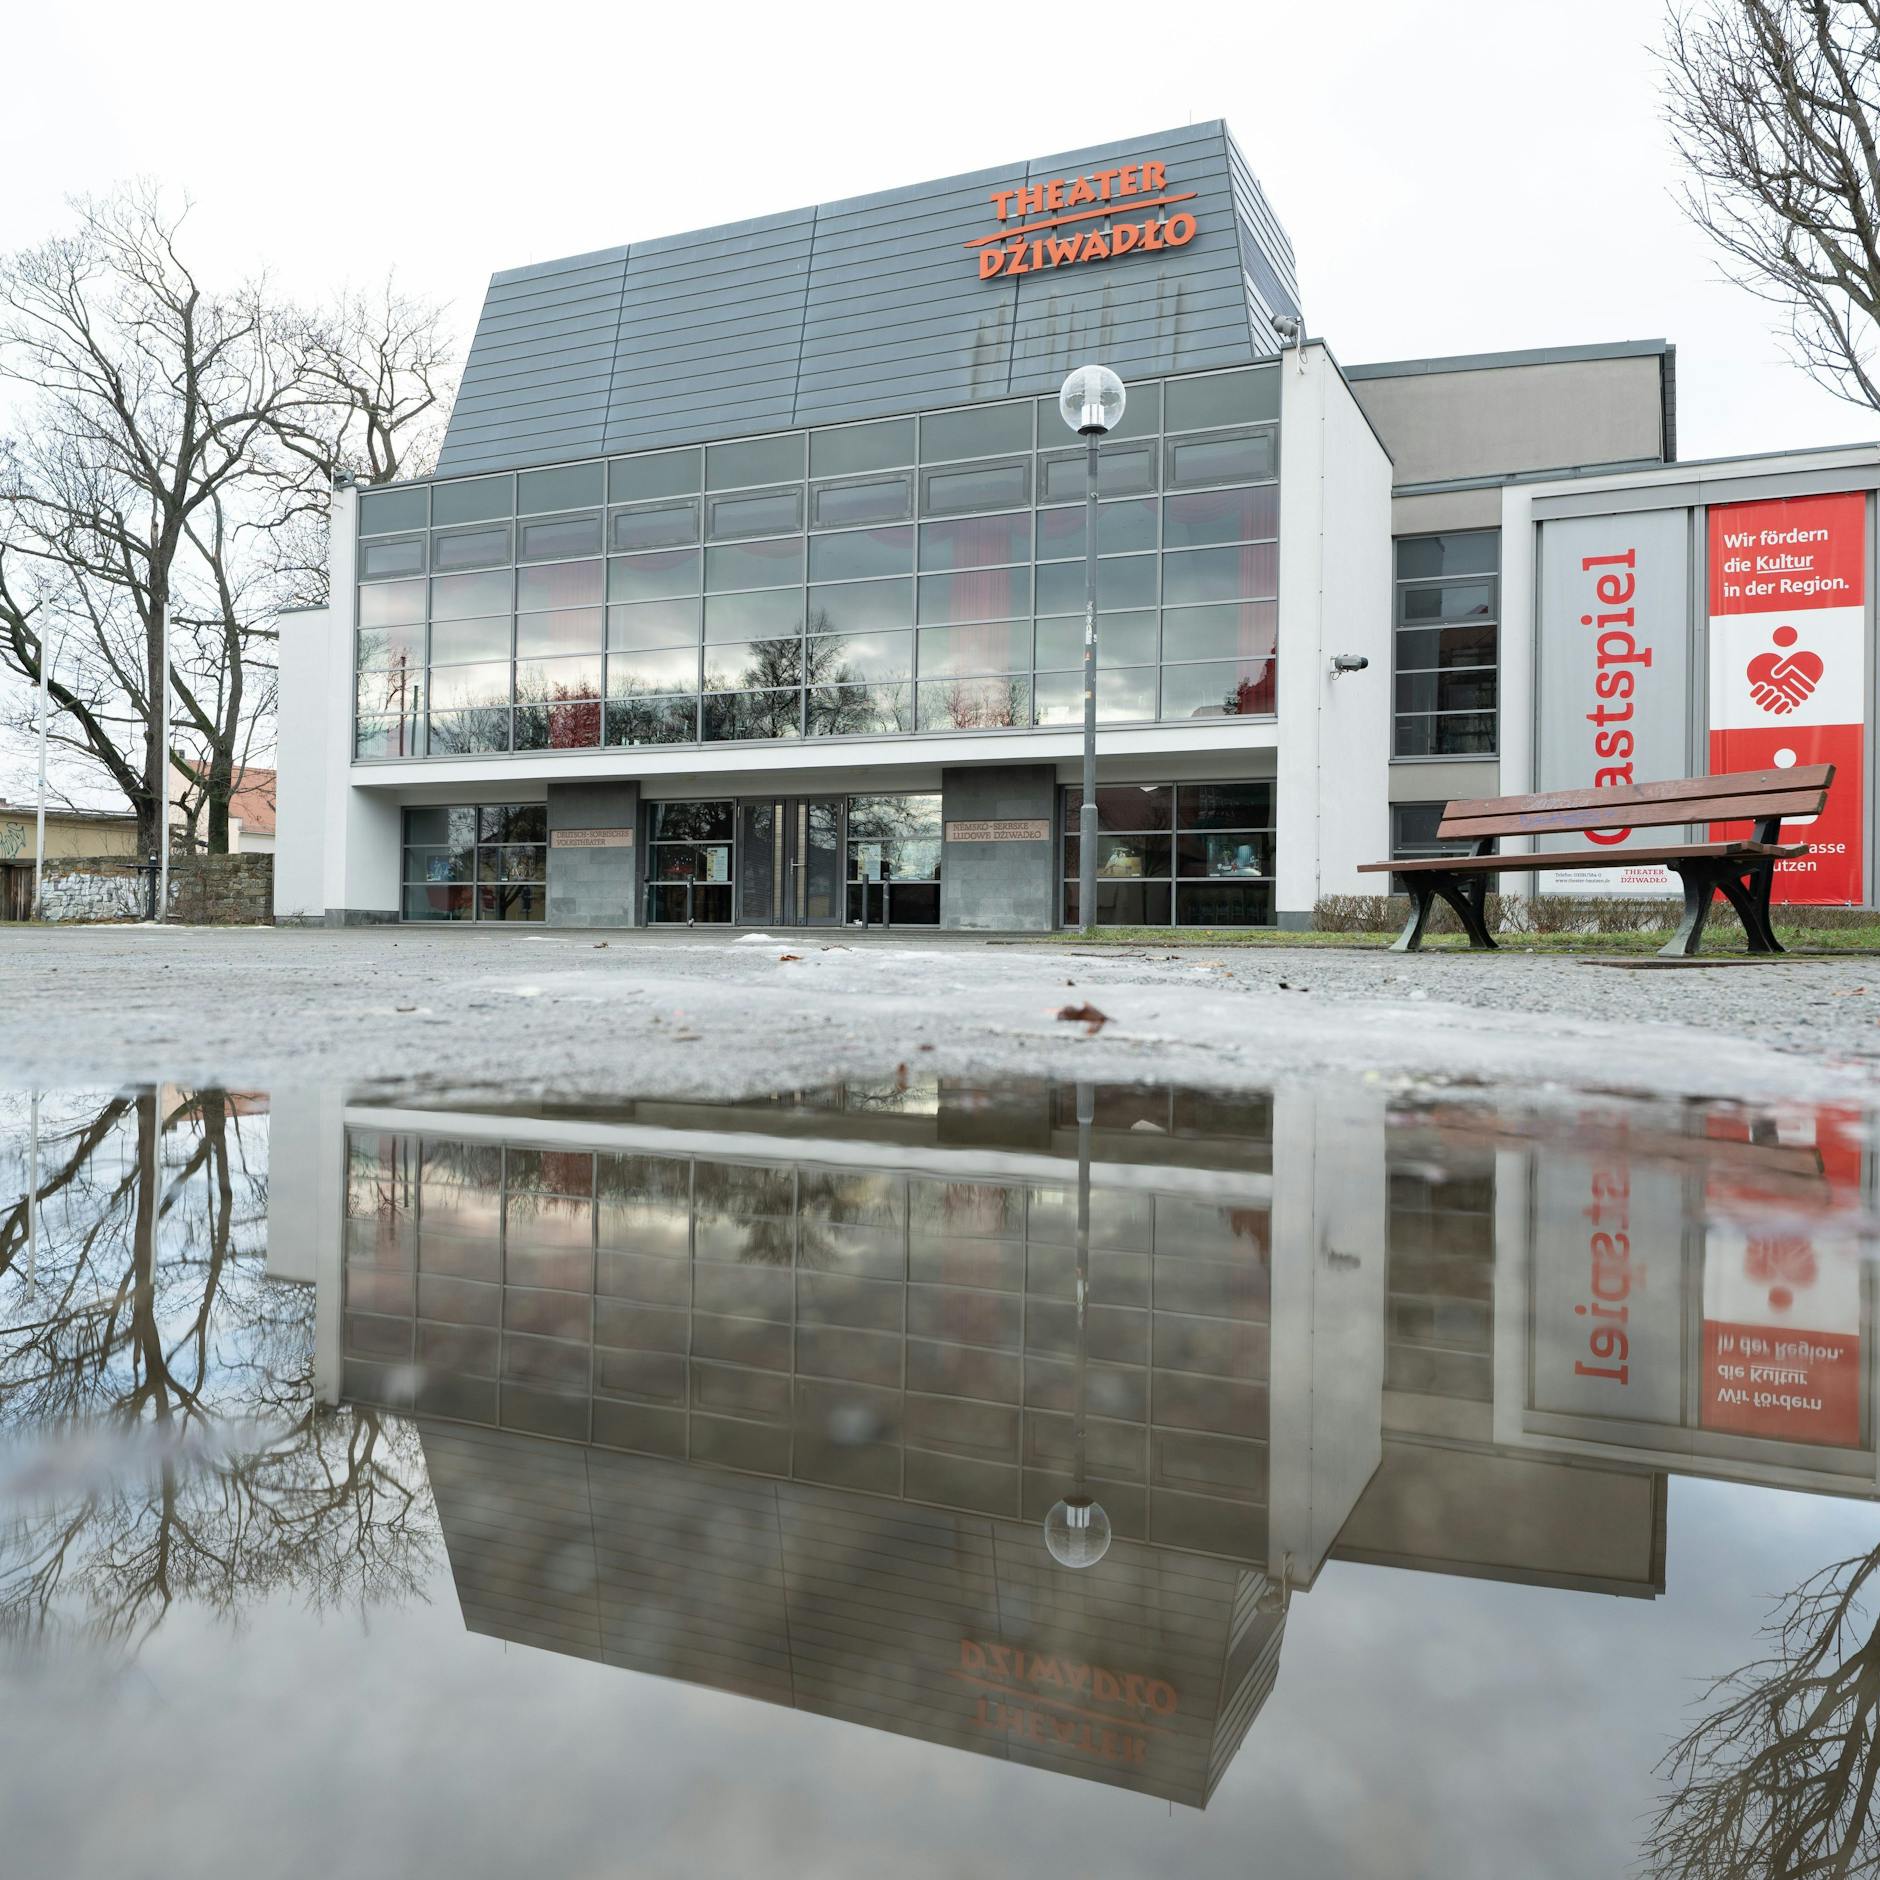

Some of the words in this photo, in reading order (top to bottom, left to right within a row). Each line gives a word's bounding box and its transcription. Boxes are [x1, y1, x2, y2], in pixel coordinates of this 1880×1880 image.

[990, 160, 1168, 220] THEATER
[979, 213, 1198, 280] DŹIWADŁO
[1723, 532, 1756, 548] Wir
[1760, 528, 1828, 546] fördern
[1723, 558, 1751, 573] die
[1756, 553, 1814, 572] Kultur
[1723, 582, 1740, 597] in
[1745, 580, 1775, 596] der
[1780, 576, 1849, 596] Region.
[1800, 841, 1846, 854] asse
[1773, 860, 1817, 872] utzen
